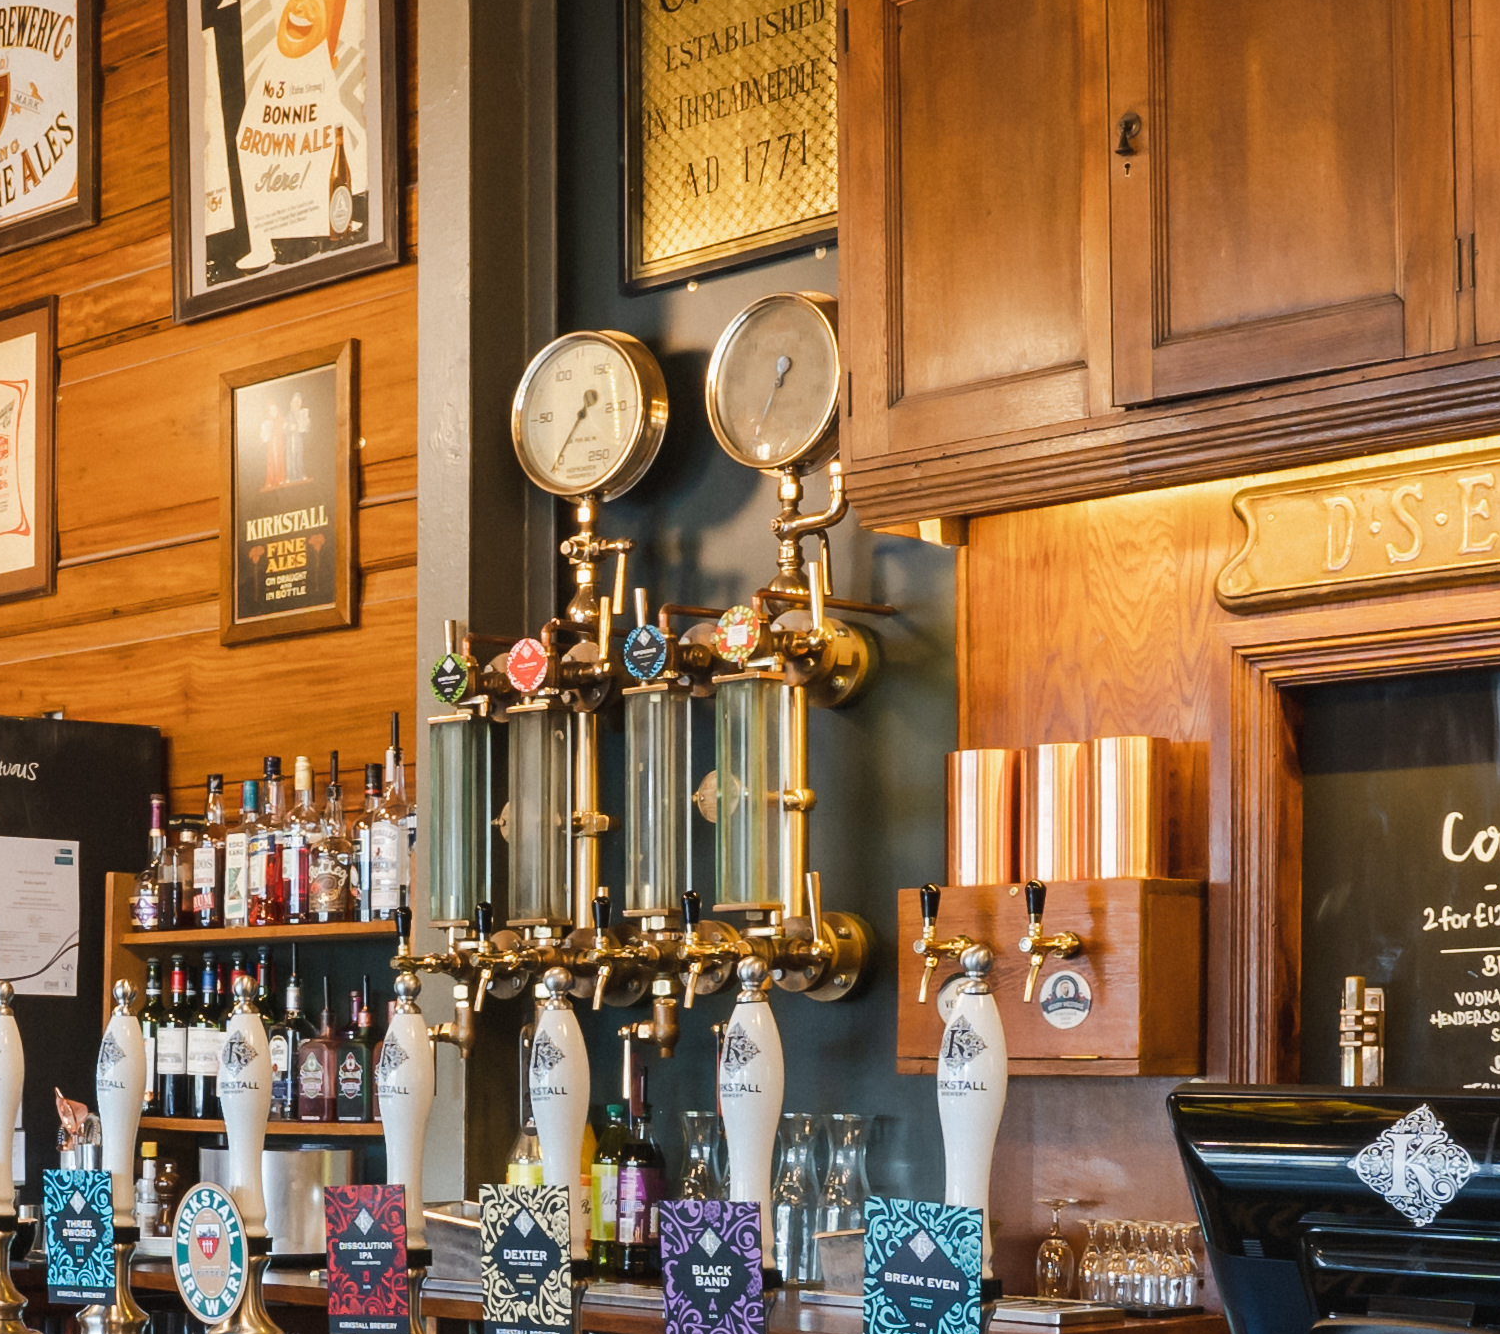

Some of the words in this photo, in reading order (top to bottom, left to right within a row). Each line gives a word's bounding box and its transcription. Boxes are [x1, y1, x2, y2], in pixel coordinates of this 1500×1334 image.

[275, 80, 286, 99] 3
[674, 55, 822, 132] THREADNEEDLE
[14, 92, 41, 111] MARK
[262, 102, 319, 126] BONNIE
[239, 125, 296, 158] BROWN
[298, 124, 334, 156] ALE
[20, 110, 75, 196] ALES
[741, 128, 809, 190] 1771
[254, 160, 312, 193] Here!
[555, 369, 573, 383] 100
[593, 363, 612, 376] 150
[539, 411, 554, 424] 50
[587, 448, 610, 462] 250
[245, 505, 329, 542] KIRKSTALL
[266, 537, 307, 558] FINE
[265, 552, 307, 574] ALES
[275, 585, 307, 600] BOTTLE
[1422, 906, 1439, 932] 2
[1438, 905, 1470, 932] for
[65, 1219, 93, 1229] THREE
[177, 1188, 241, 1245] KIRKSTALL
[62, 1228, 97, 1238] SWORDS
[338, 1240, 393, 1251] DISSOLUTION
[502, 1248, 548, 1262] DEXTER
[358, 1250, 373, 1261] IPA
[691, 1264, 732, 1277] BLACK
[179, 1260, 243, 1317] BREWERY
[694, 1275, 730, 1288] BAND
[884, 1271, 925, 1287] BREAK
[926, 1277, 960, 1292] EVEN
[338, 1321, 370, 1330] KIRKSTALL
[369, 1321, 398, 1330] BREWERY
